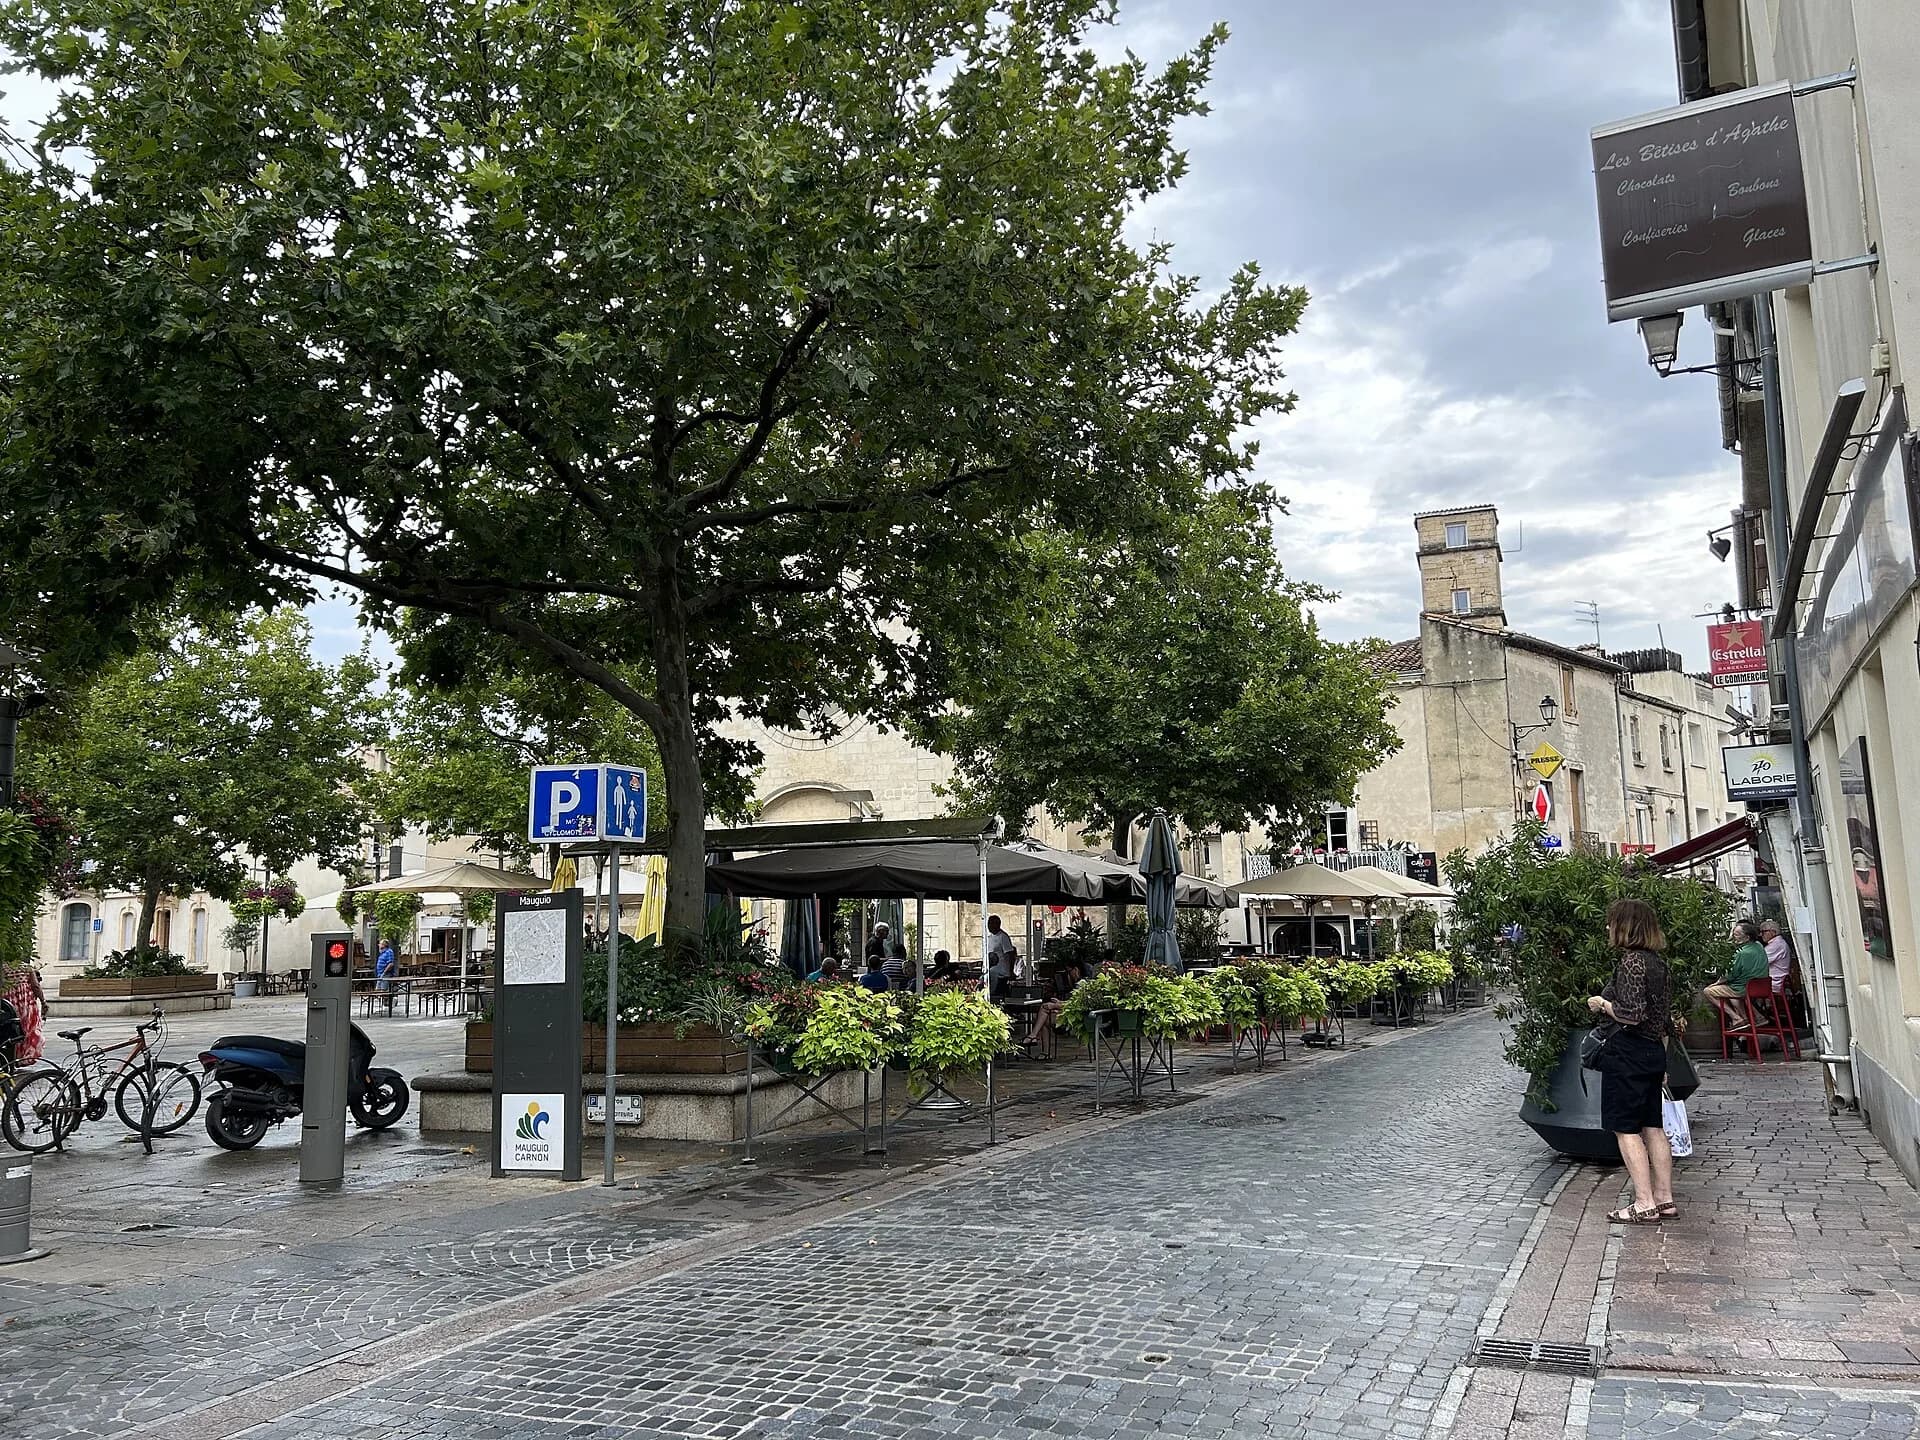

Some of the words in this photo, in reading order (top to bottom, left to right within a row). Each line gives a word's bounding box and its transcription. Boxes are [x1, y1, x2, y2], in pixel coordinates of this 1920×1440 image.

[1600, 152, 1631, 171] Les
[1639, 140, 1698, 162] Bêtises
[1617, 173, 1676, 196] Chocolats
[1728, 177, 1781, 197] Bonbons
[1621, 223, 1689, 248] Confiseries
[1743, 225, 1787, 248] Glaces
[1711, 646, 1762, 661] Estrella
[1715, 674, 1724, 685] LE
[1530, 755, 1560, 765] PRESSE
[551, 780, 581, 827] P
[519, 895, 552, 907] Mauguio
[515, 1143, 549, 1153] MAUGUIO
[515, 1153, 549, 1162] CARNON
